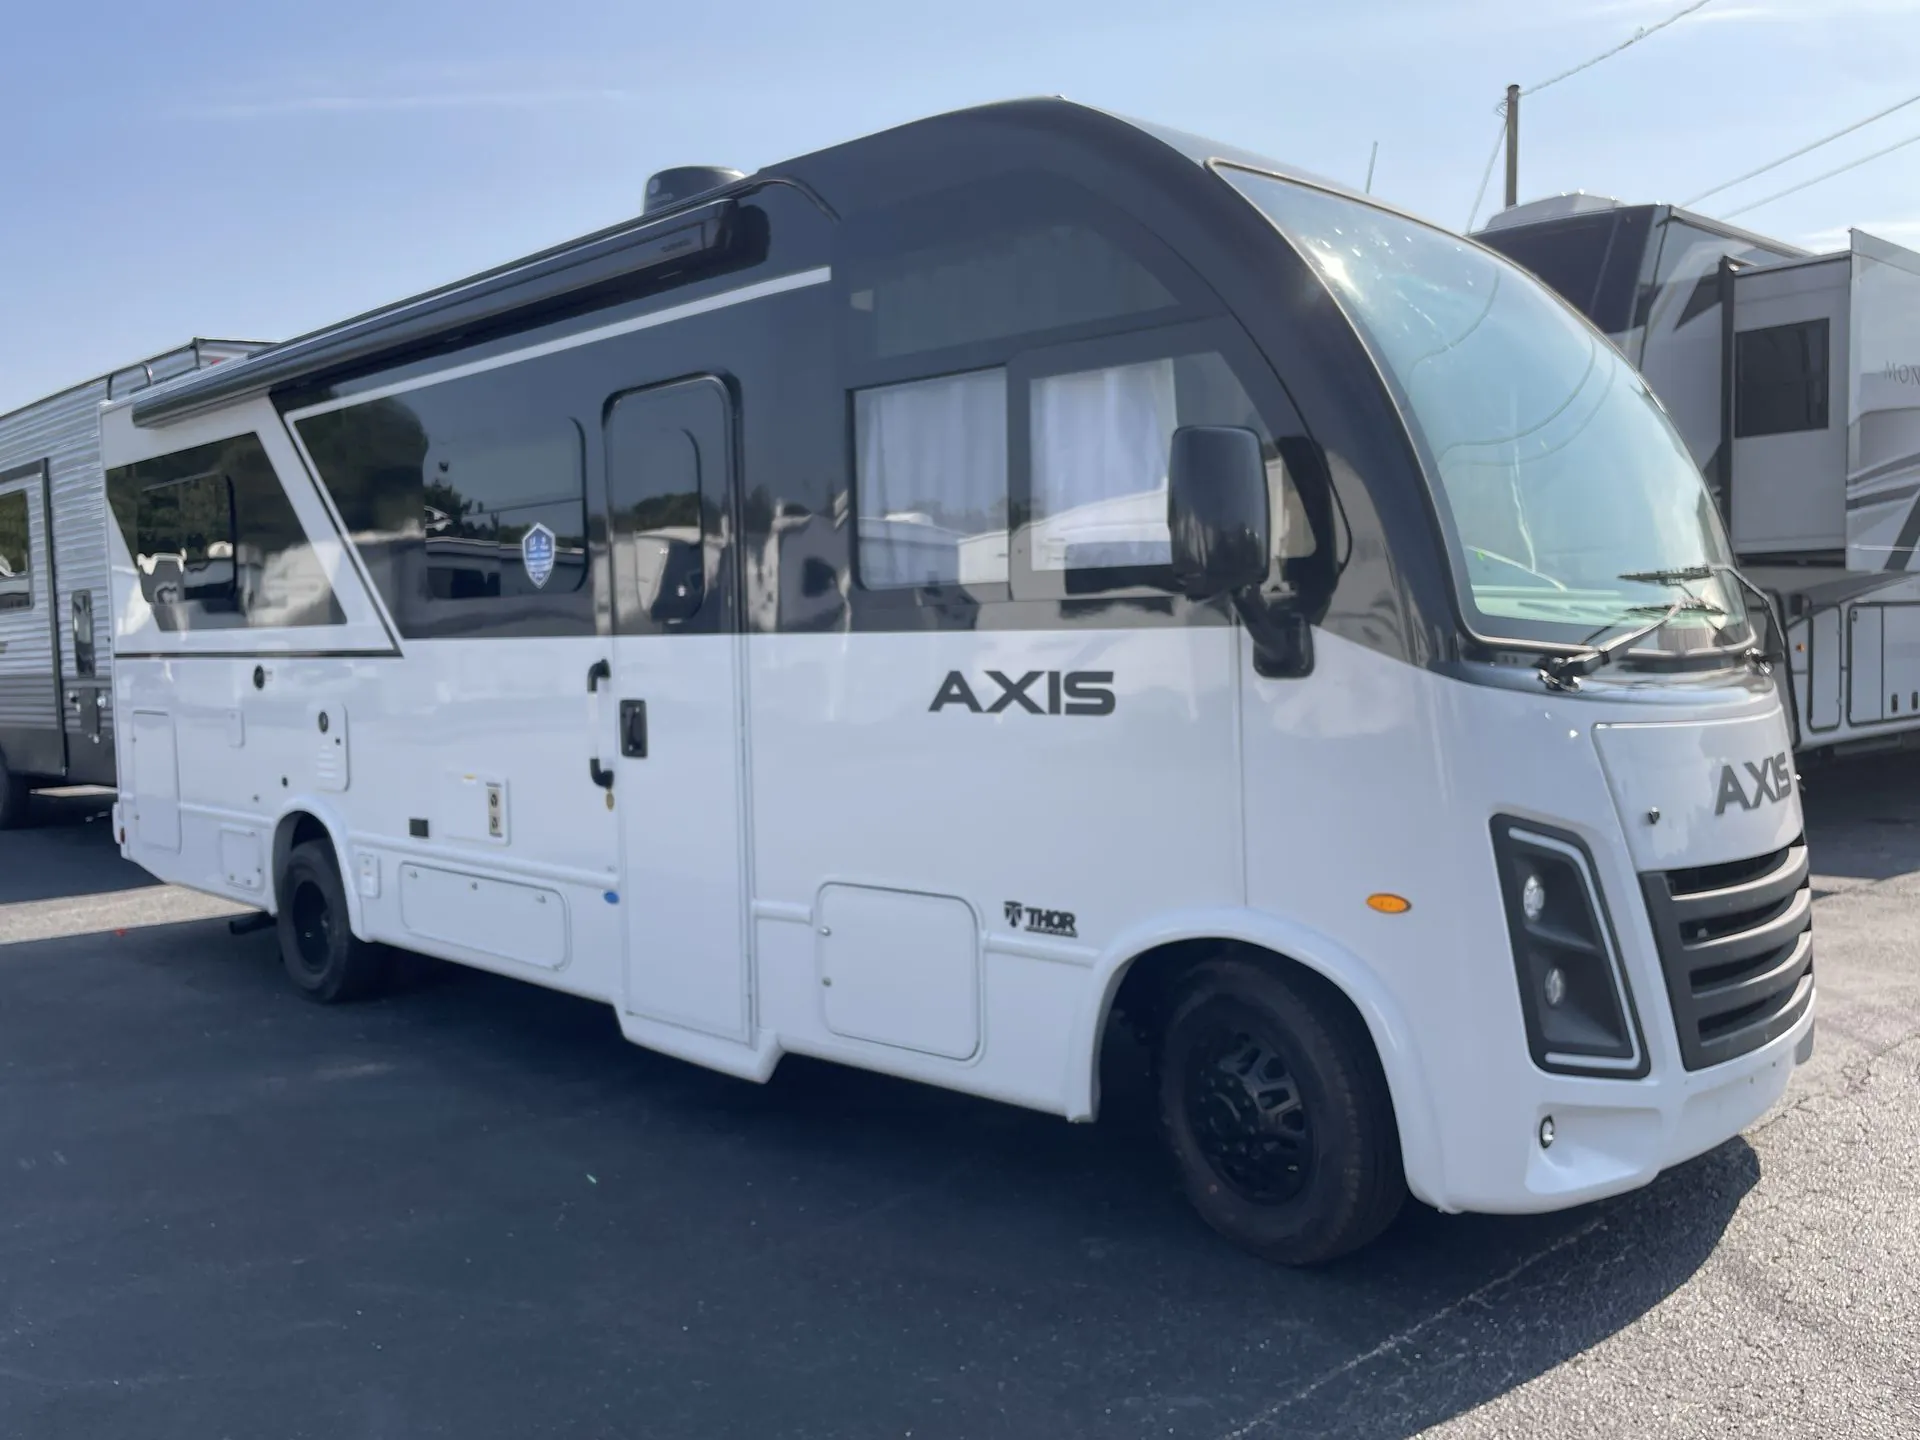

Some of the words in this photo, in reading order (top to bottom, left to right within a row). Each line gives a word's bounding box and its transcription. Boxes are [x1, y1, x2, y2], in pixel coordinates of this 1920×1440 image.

[928, 670, 1116, 717] AXIS
[1714, 751, 1792, 817] AXIS
[1024, 906, 1076, 932] THOR
